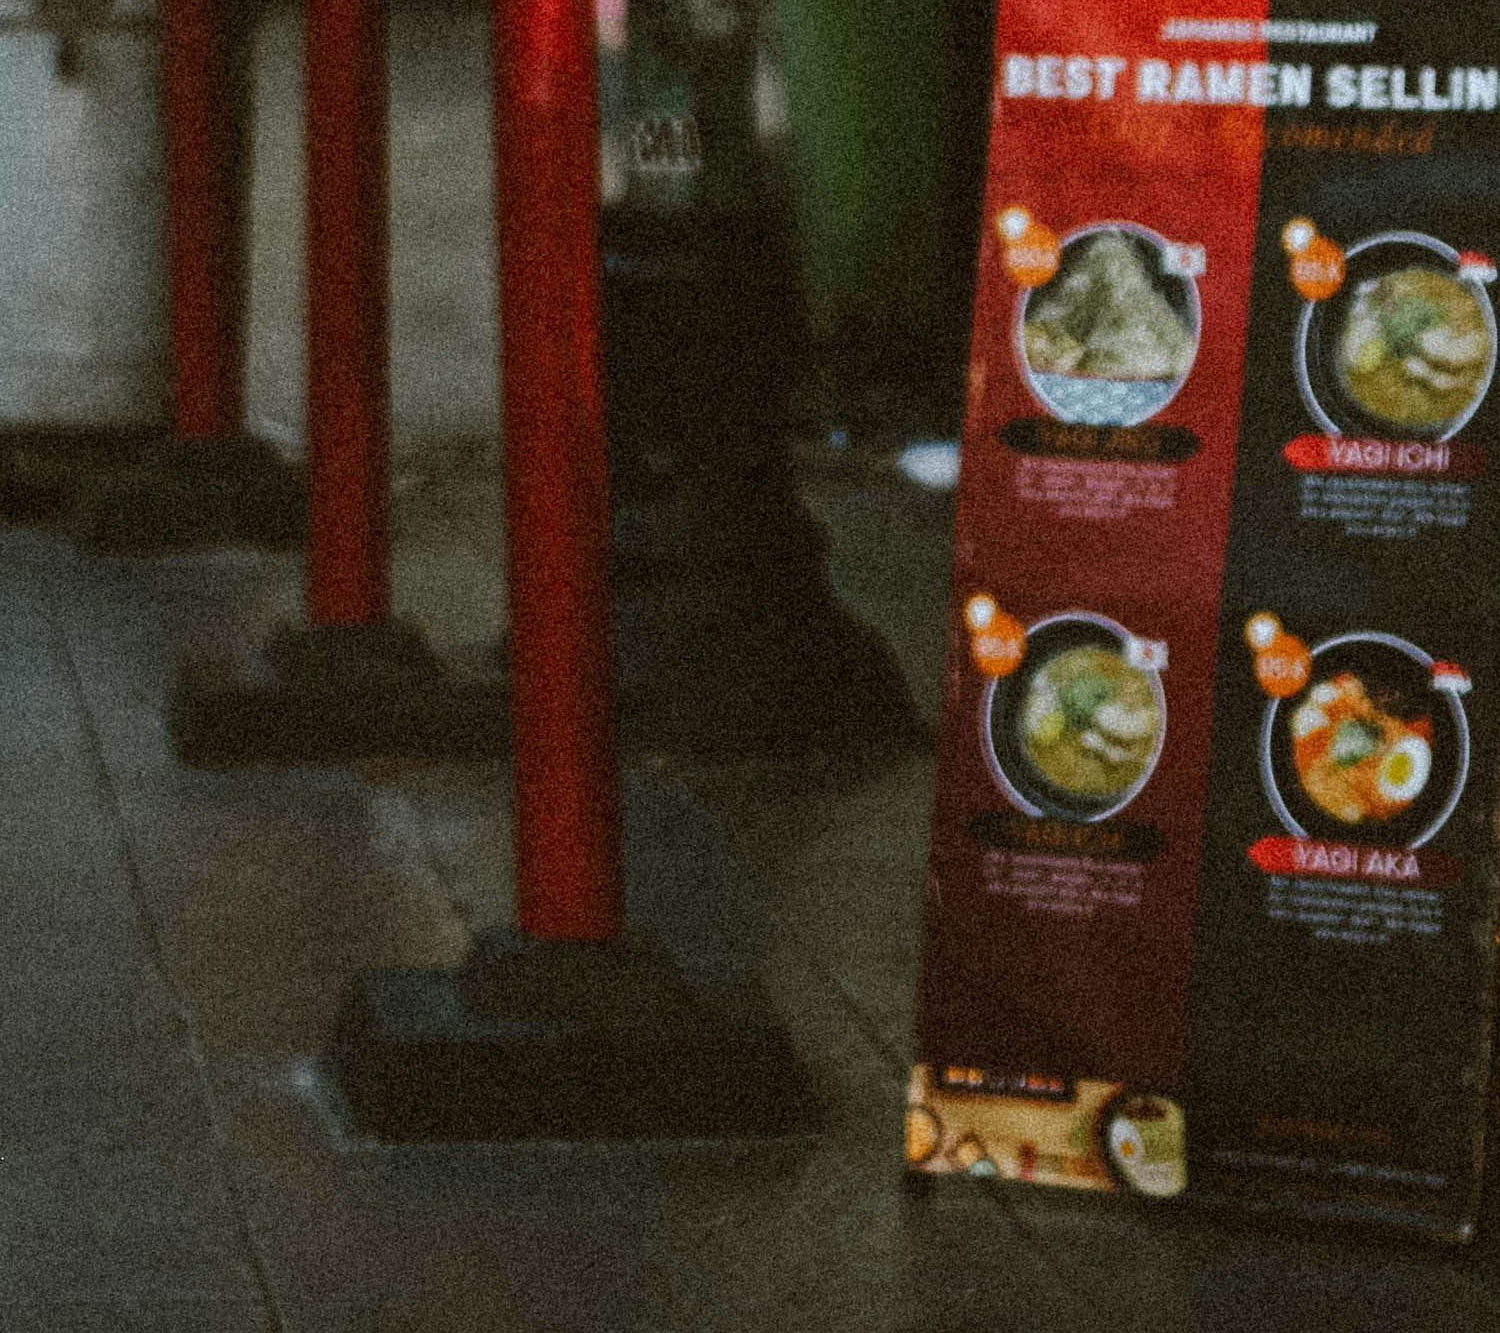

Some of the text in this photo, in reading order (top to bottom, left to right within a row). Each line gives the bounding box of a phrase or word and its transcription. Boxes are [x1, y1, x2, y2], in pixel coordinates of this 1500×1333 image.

[1003, 55, 1126, 101] BEST
[1137, 58, 1312, 107] RAMEN
[1363, 851, 1423, 878] AKA
